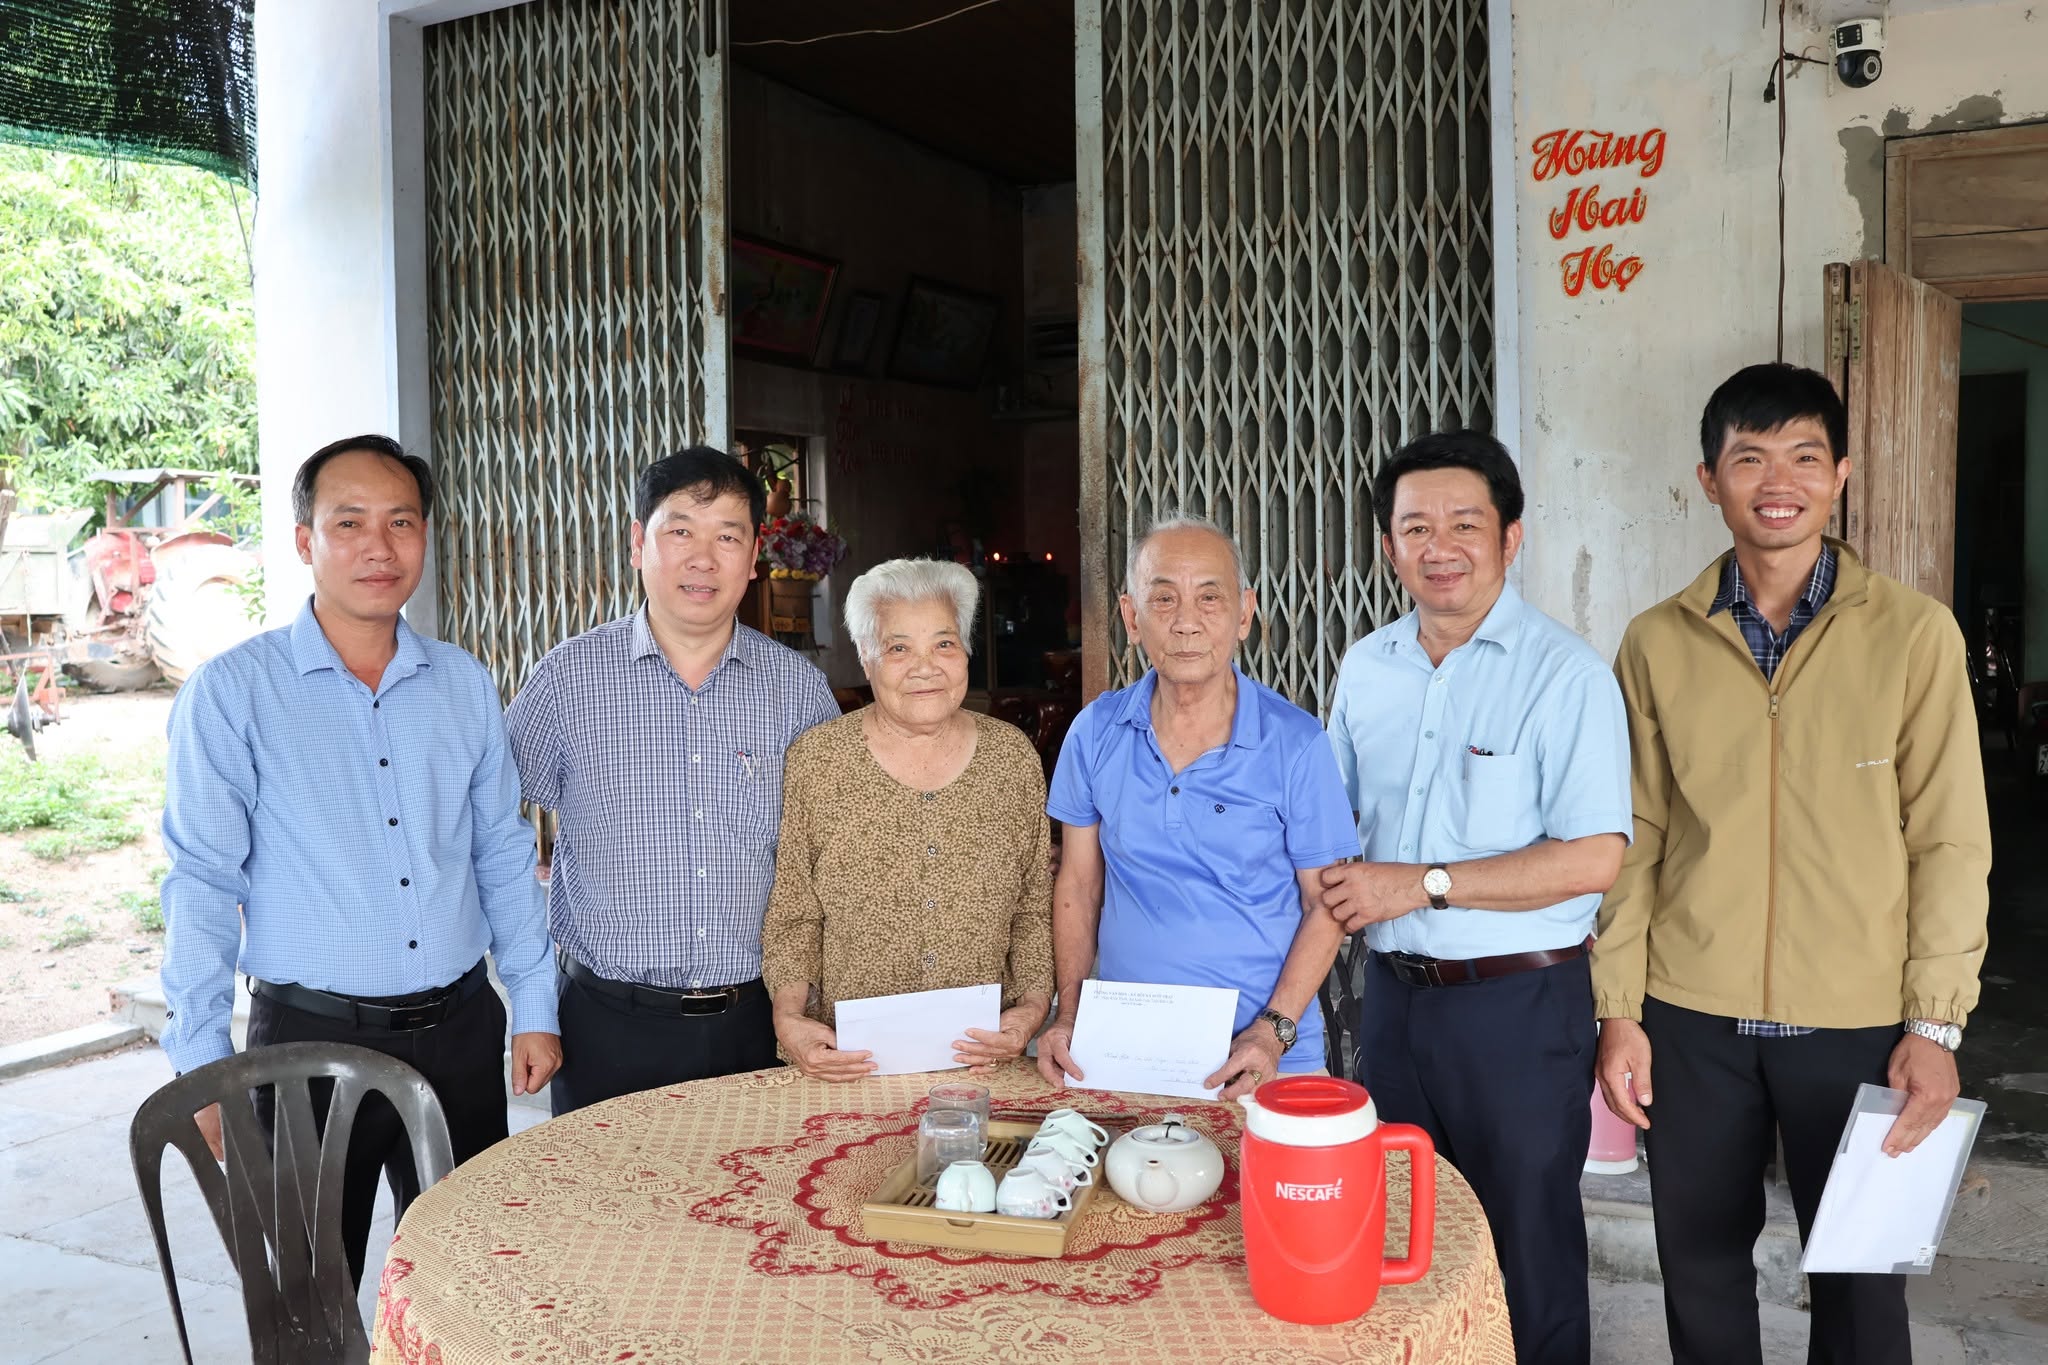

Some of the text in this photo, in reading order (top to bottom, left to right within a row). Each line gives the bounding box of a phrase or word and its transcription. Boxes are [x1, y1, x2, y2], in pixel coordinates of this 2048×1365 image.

[1549, 184, 1647, 240] Hai
[1560, 243, 1645, 297] Họ
[1275, 1178, 1343, 1201] NESCAFÉ
